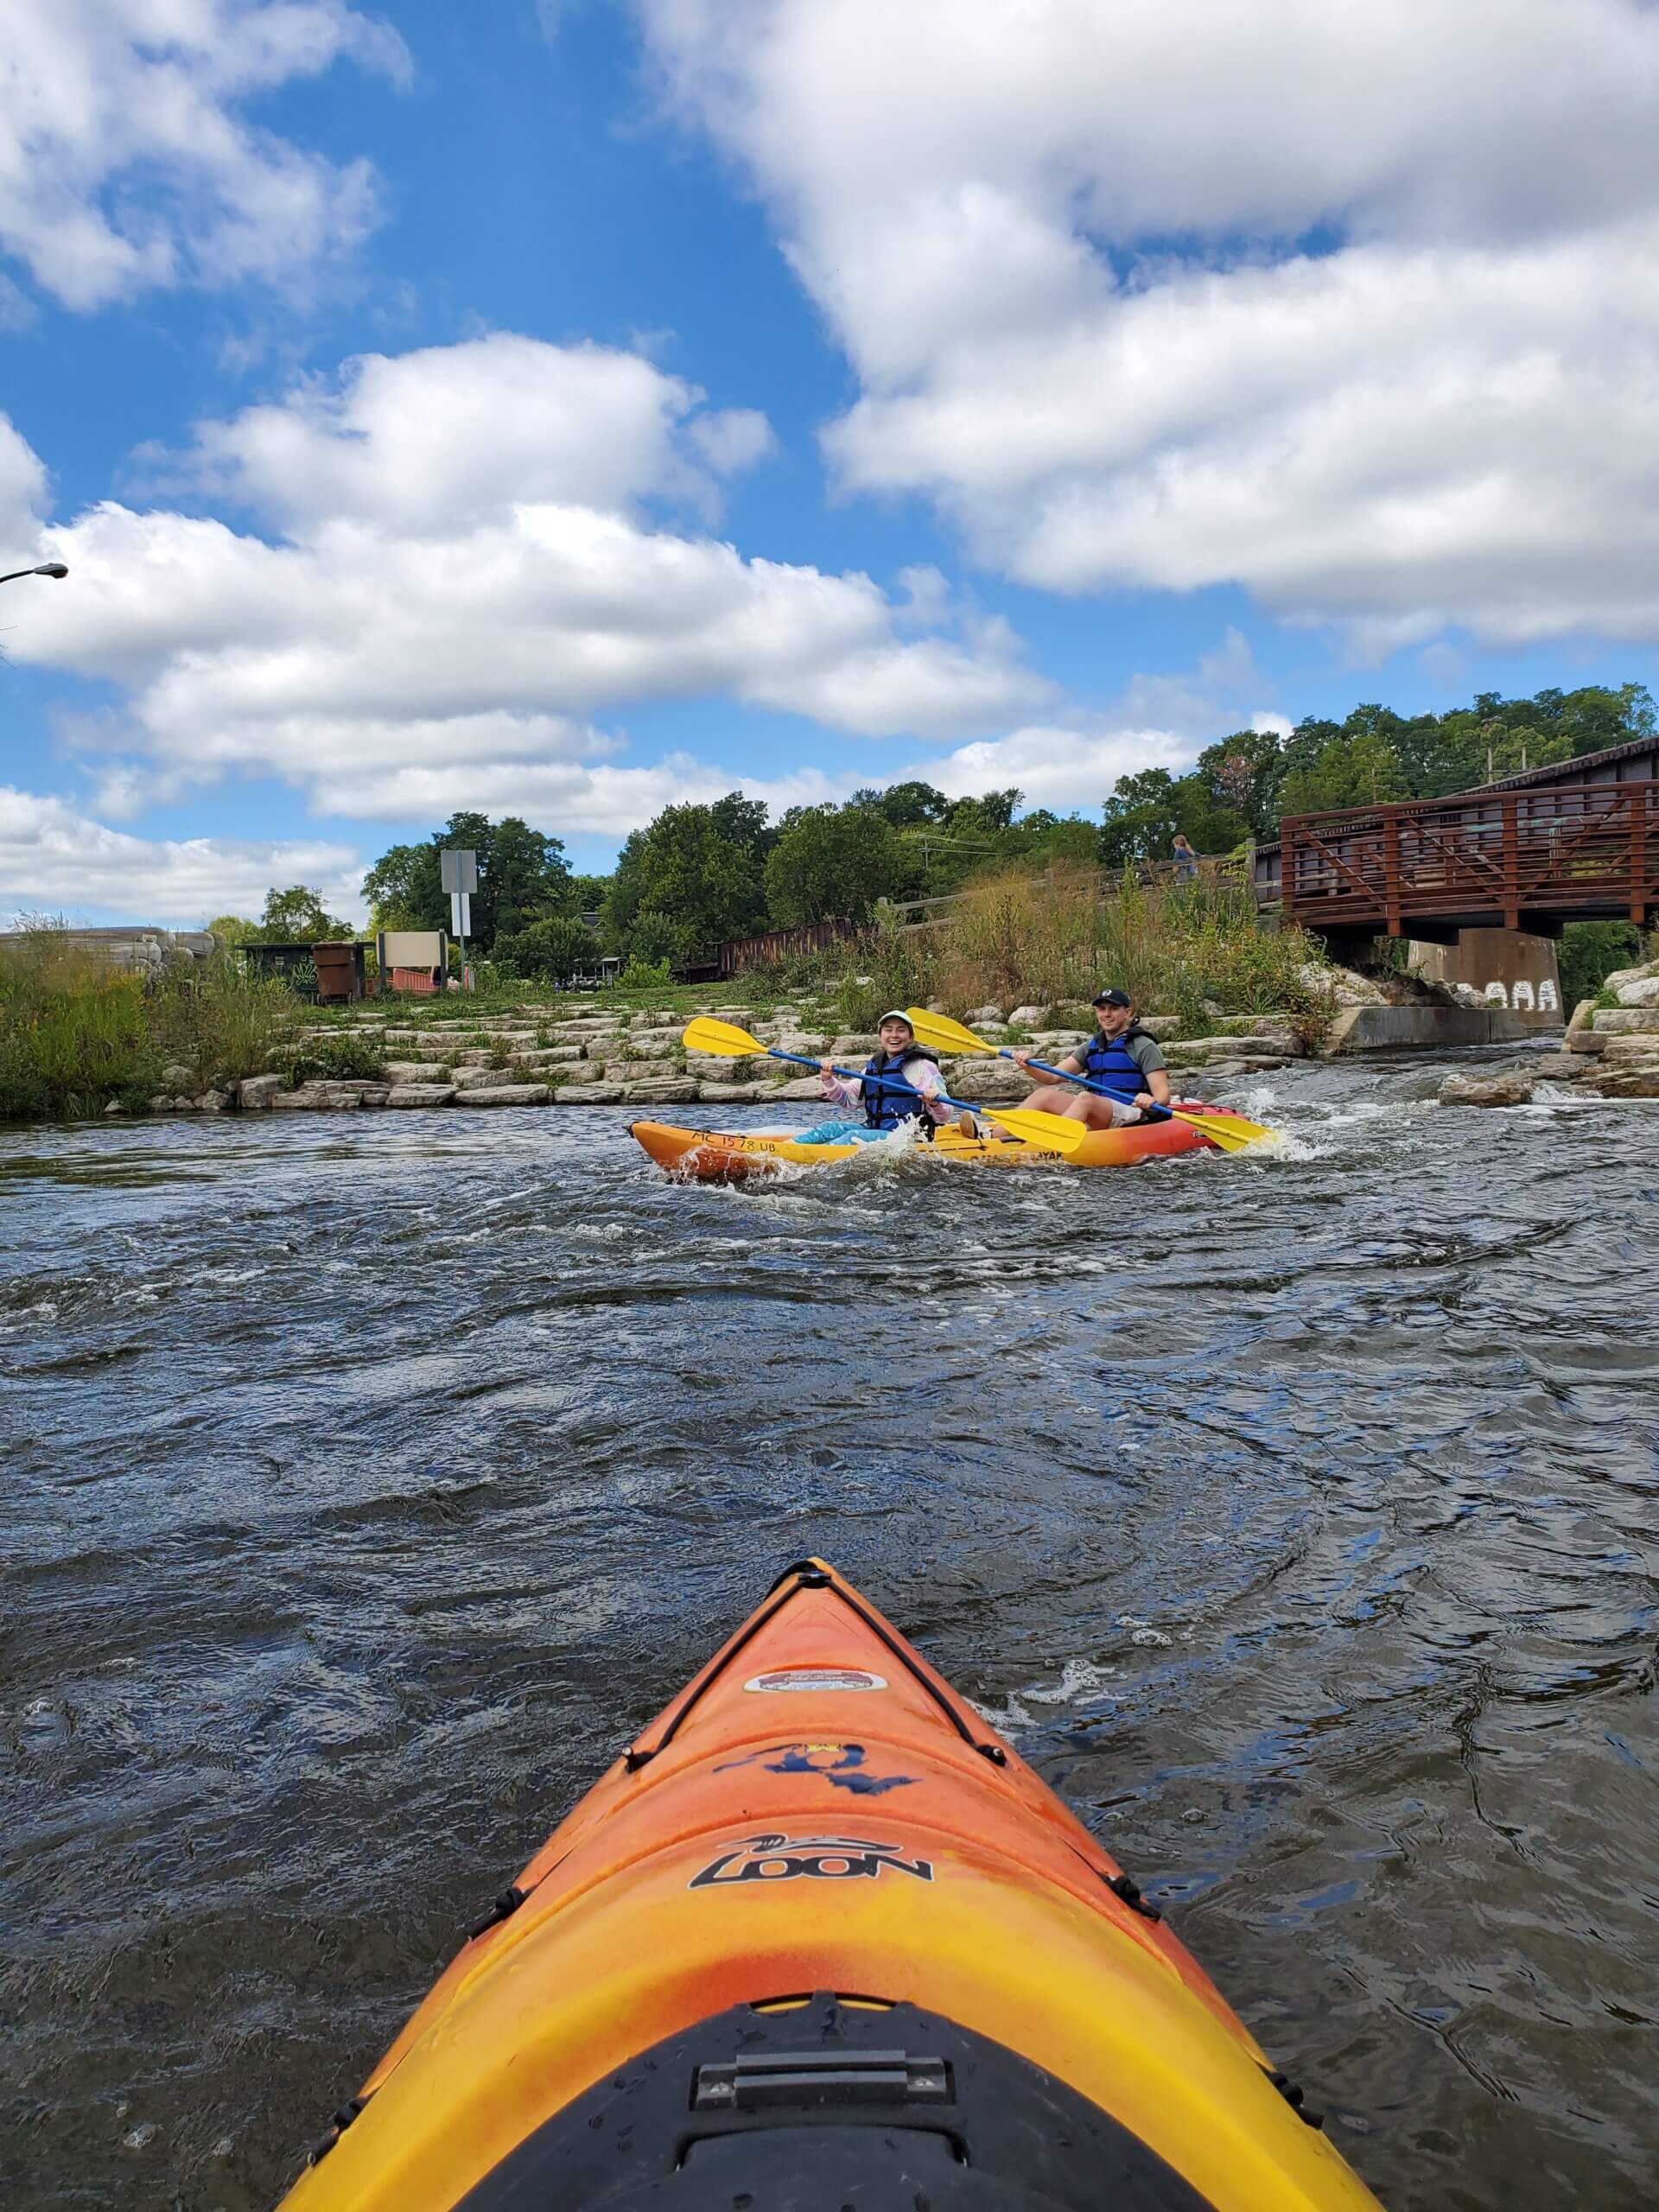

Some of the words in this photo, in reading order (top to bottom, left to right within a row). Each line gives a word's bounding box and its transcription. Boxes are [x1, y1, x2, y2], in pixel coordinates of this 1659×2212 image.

[691, 1133, 715, 1143] MC
[722, 1136, 755, 1152] 1578
[760, 1142, 776, 1153] UB
[689, 1851, 933, 1888] LOON
